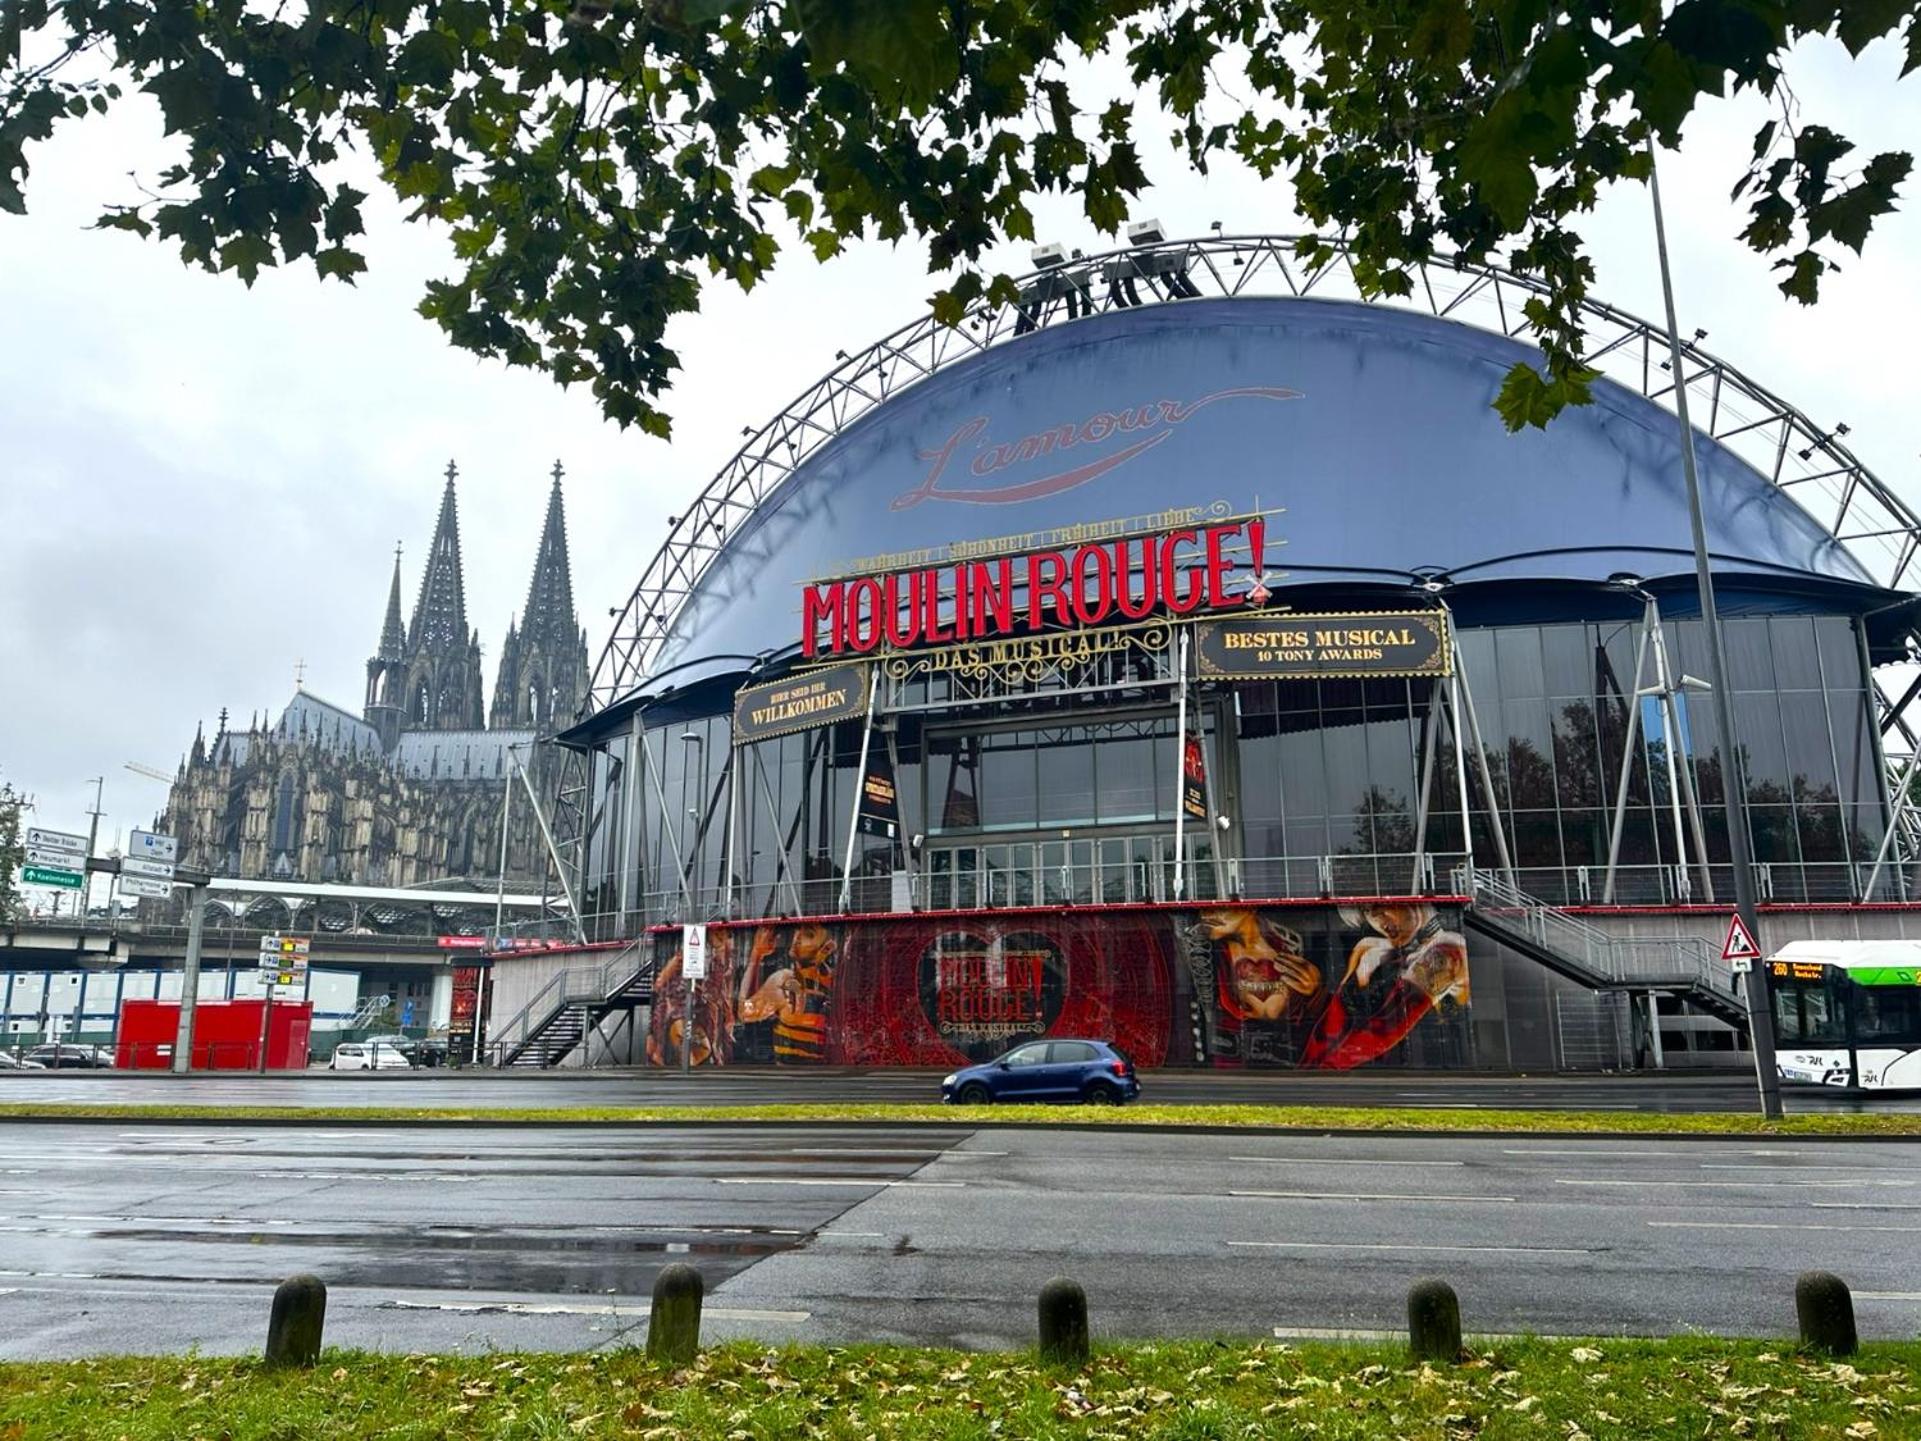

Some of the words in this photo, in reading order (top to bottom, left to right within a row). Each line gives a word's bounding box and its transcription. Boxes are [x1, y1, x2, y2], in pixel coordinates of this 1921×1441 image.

[802, 557, 1012, 658] MOULIN
[1028, 519, 1273, 631] ROUGE!
[935, 648, 980, 669] DAS
[993, 631, 1120, 663] MUSICAL!
[1223, 630, 1309, 649] BESTES
[1315, 628, 1416, 647] MUSICAL
[1257, 651, 1273, 662] 10
[1277, 650, 1314, 661] TONY
[1318, 648, 1383, 660] AWARDS
[752, 689, 847, 726] WILLKOMMEN
